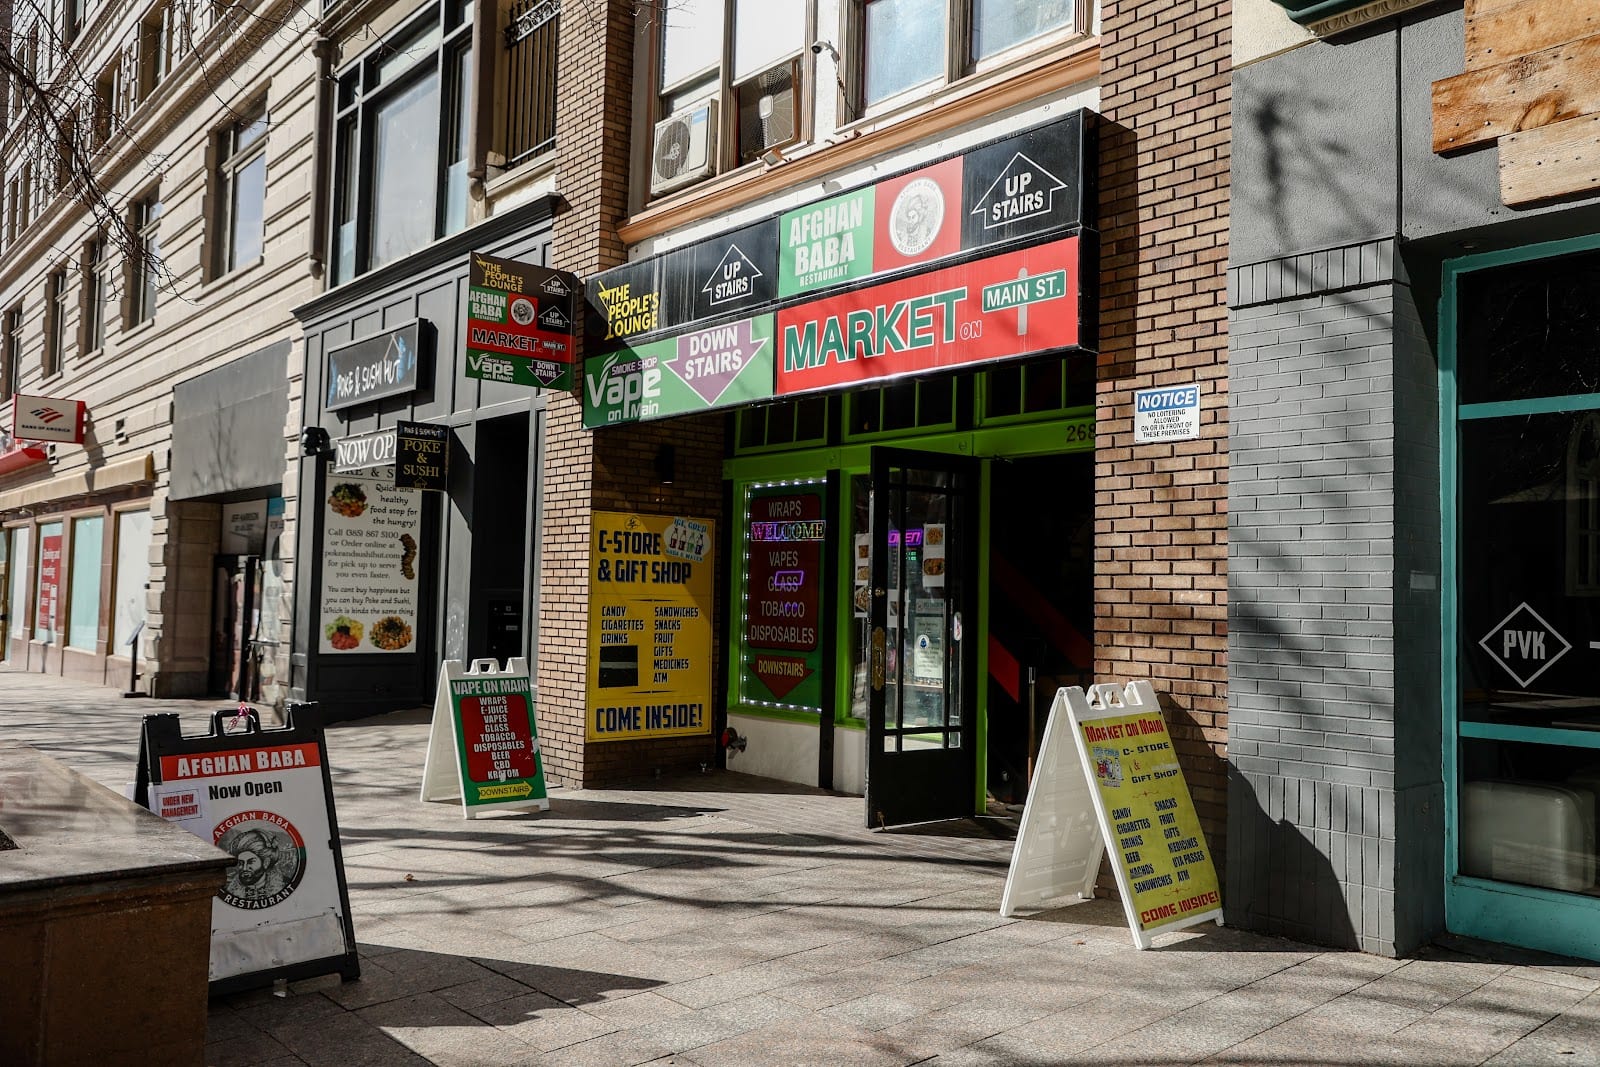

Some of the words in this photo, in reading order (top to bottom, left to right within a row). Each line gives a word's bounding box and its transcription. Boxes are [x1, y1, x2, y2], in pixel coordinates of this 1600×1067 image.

[1005, 172, 1032, 197] UP
[992, 191, 1043, 220] STAIRS
[789, 198, 862, 248] AFGHAN
[795, 232, 855, 276] BABA
[486, 262, 501, 272] THE
[723, 262, 740, 280] UP
[485, 270, 523, 285] PEOPLE'S
[800, 264, 848, 287] RESTAURANT
[482, 276, 523, 293] LOUNGE
[547, 286, 565, 295] STAIRS
[715, 277, 748, 299] STAIRS
[986, 283, 1028, 309] MAIN
[1035, 276, 1061, 298] ST.
[470, 290, 506, 308] AFGHAN
[609, 284, 630, 304] THE
[472, 302, 503, 319] BABA
[608, 292, 659, 319] PEOPLE'S
[546, 317, 563, 326] STAIRS
[605, 311, 658, 340] LOUNGE
[784, 286, 967, 373] MARKET
[960, 320, 982, 340] ON
[471, 328, 539, 352] MARKET
[689, 326, 738, 356] DOWN
[468, 356, 514, 380] Vape
[537, 362, 556, 370] DOWN
[611, 363, 637, 376] SMOKE
[637, 358, 658, 370] SHOP
[685, 349, 742, 380] STAIRS
[337, 371, 354, 399] POKE
[354, 366, 360, 397] &
[362, 360, 382, 391] SUSHI
[383, 359, 401, 384] HUT
[535, 369, 557, 378] STAIRS
[586, 366, 661, 419] Vape
[1139, 390, 1196, 410] NOTICE
[608, 409, 622, 422] on
[629, 401, 659, 420] Main
[1156, 409, 1186, 418] LOITERING
[1153, 416, 1180, 425] ALLOWED
[1066, 423, 1096, 443] 268
[1161, 429, 1191, 437] PREMISES
[336, 438, 372, 467] NOW
[404, 440, 441, 454] POKE
[416, 453, 428, 464] &
[371, 467, 380, 477] &
[403, 464, 439, 477] SUSHI
[379, 494, 409, 506] healthy
[370, 505, 387, 514] food
[389, 508, 405, 517] stop
[407, 507, 418, 516] for
[768, 500, 801, 517] WRAPS
[373, 516, 385, 524] the
[328, 528, 343, 536] Call
[751, 522, 825, 540] WELCOME
[598, 530, 661, 555] C-STORE
[768, 551, 799, 567] VAPES
[598, 559, 612, 582] &
[615, 559, 649, 583] GIFT
[651, 561, 692, 584] SHOP
[767, 576, 799, 592] GLASS
[601, 606, 627, 617] CANDY
[654, 606, 700, 618] SANDWICHES
[760, 600, 805, 618] TOBACCO
[601, 619, 644, 631] CIGARETTES
[654, 619, 681, 631] SNACKS
[601, 633, 628, 644] DRINKS
[654, 632, 674, 644] FRUIT
[750, 625, 814, 645] DISPOSABLES
[654, 645, 673, 657] GIFTS
[1503, 629, 1546, 660] PVK
[653, 658, 689, 670] MEDICINES
[758, 660, 804, 677] DOWNSTAIRS
[653, 672, 668, 683] ATM
[452, 681, 481, 695] VAPE
[483, 680, 499, 693] ON
[501, 679, 529, 693] MAIN
[479, 696, 507, 705] WRAPS
[481, 705, 508, 715] E-JUICE
[596, 706, 642, 733] COME
[645, 703, 704, 730] INSIDE!
[484, 714, 508, 724] VAPES
[484, 723, 509, 733] GLASS
[1085, 724, 1124, 743] MARKET
[1125, 723, 1140, 737] ON
[1138, 719, 1164, 735] MAIN
[480, 732, 516, 742] TOBACCO
[474, 740, 525, 752] DISPOSABLES
[1137, 742, 1170, 754] STORE
[177, 754, 251, 777] AFGHAN
[256, 749, 306, 770] BABA
[491, 751, 510, 760] BEER
[494, 760, 511, 770] CBD
[1133, 758, 1141, 771] &
[488, 769, 520, 780] KRATOM
[1131, 774, 1152, 784] GIFT
[1153, 769, 1178, 780] SHOP
[208, 785, 241, 801] Now
[245, 780, 283, 797] Open
[480, 785, 529, 796] DOWNSTAIRS
[163, 795, 181, 807] UNDER
[181, 793, 194, 805] NEW
[1154, 797, 1178, 812] SNACKS
[162, 804, 199, 818] MANAGEMENT
[1112, 807, 1132, 821] CANDY
[1159, 812, 1176, 826] FRUIT
[214, 812, 256, 839] AFGHAN
[262, 812, 290, 830] BABA
[1116, 818, 1151, 835] CIGARETTES
[1163, 826, 1180, 840] GIFTS
[1120, 834, 1144, 850] DRINKS
[1167, 836, 1199, 854] MEDICINES
[1125, 850, 1141, 864] BEER
[1172, 855, 1184, 868] UTA
[1184, 850, 1205, 864] PASSES
[1134, 873, 1173, 894] SANDWICHES
[1177, 869, 1190, 882] ATM
[224, 884, 295, 910] RESTAURANT
[1140, 903, 1178, 924] COME
[1179, 890, 1219, 913] INSIDE!
